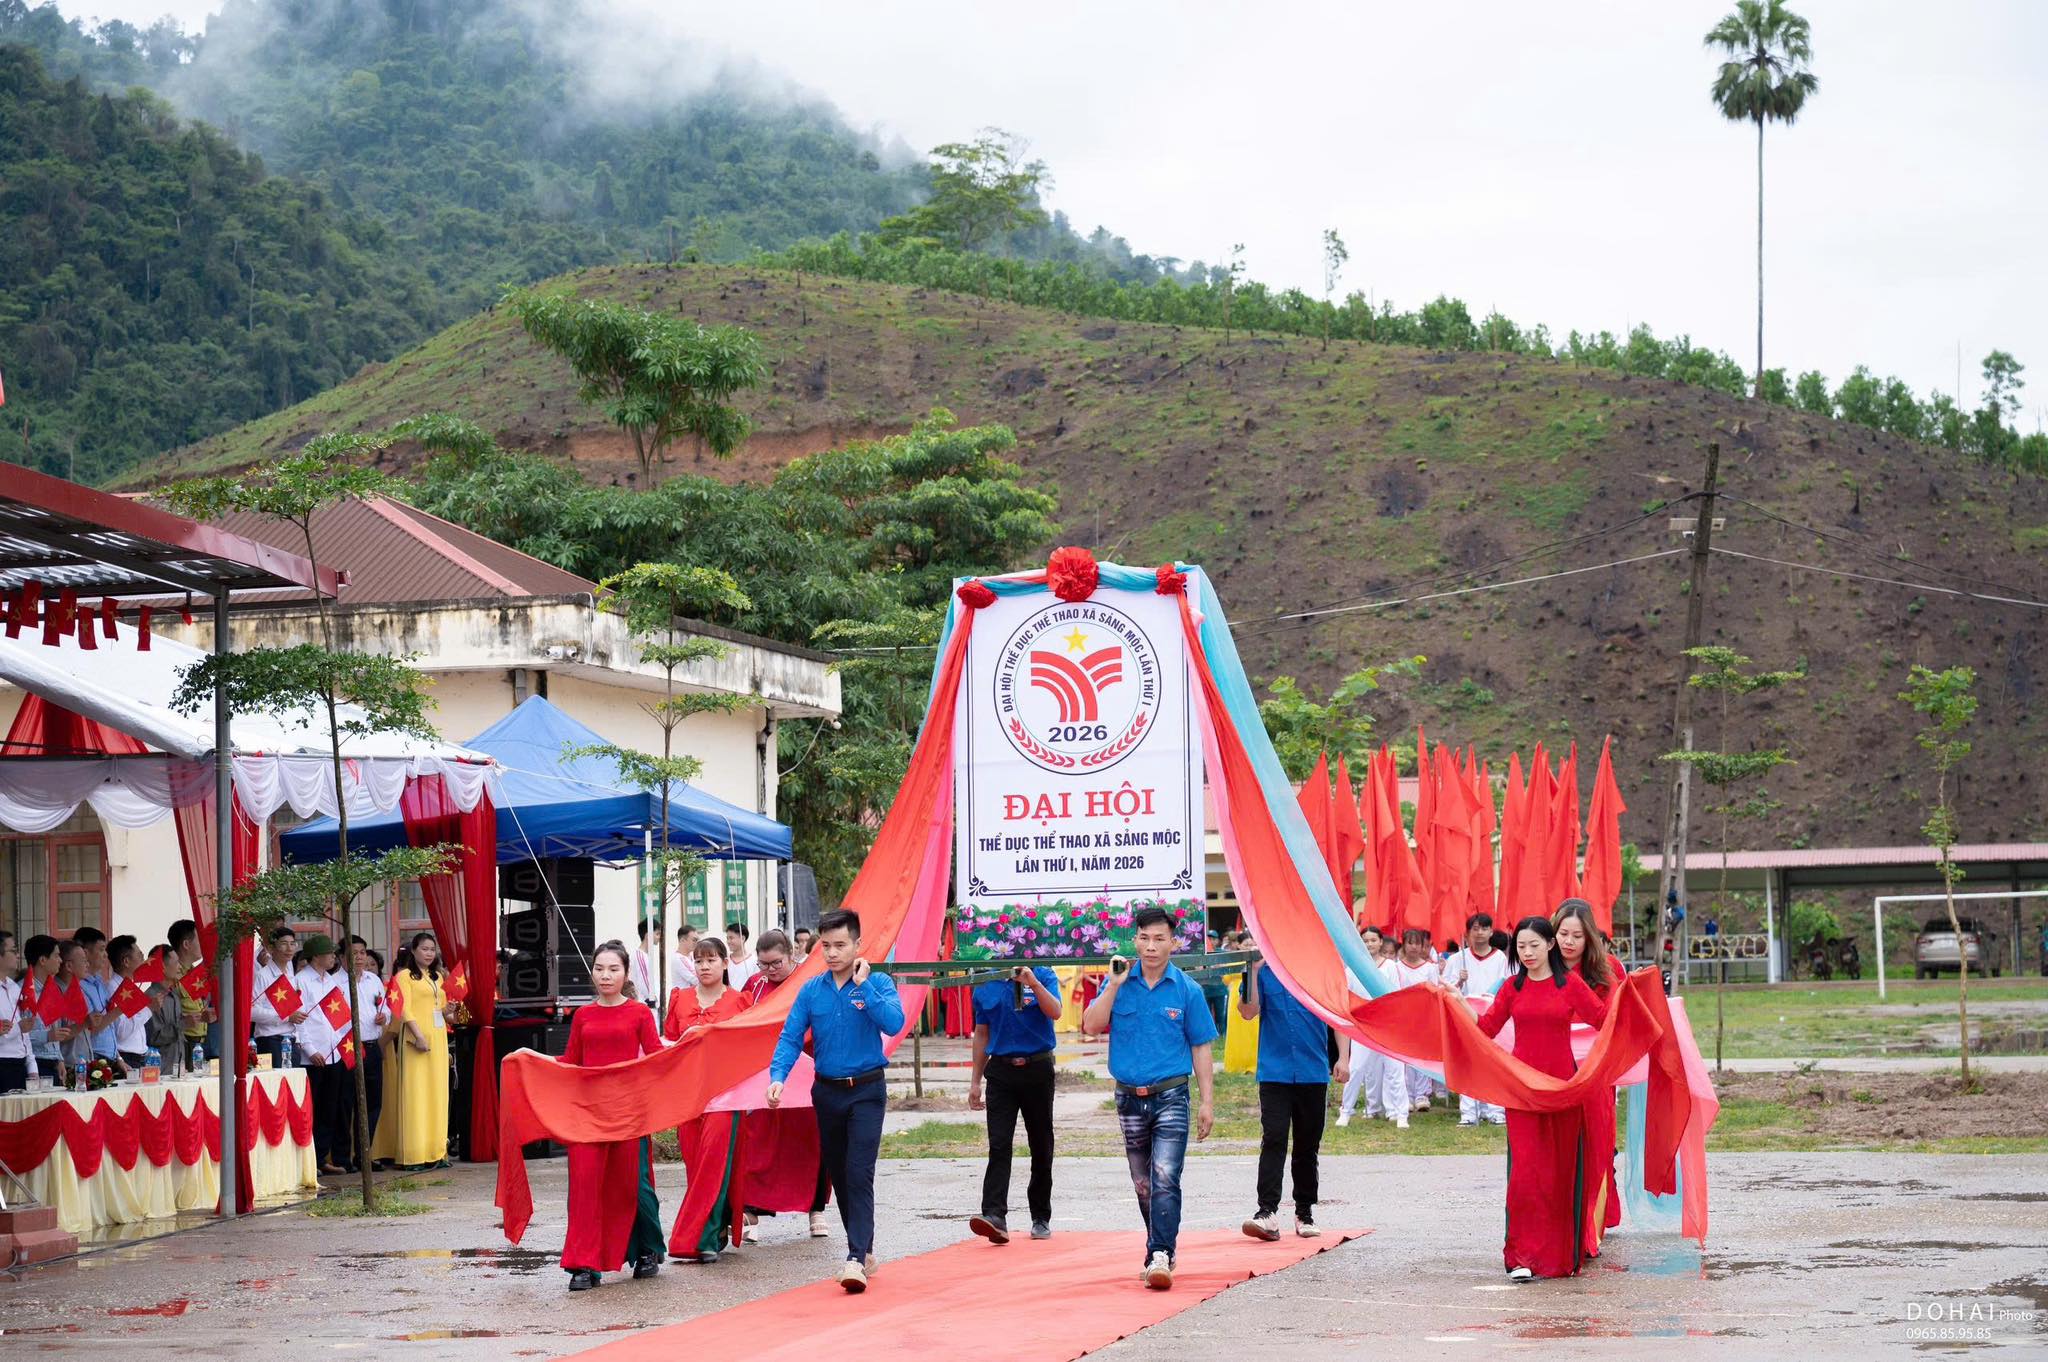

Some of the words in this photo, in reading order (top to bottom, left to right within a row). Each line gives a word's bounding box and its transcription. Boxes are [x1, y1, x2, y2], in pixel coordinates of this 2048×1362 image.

[1032, 612, 1051, 632] THỂ
[1052, 609, 1078, 622] THAO
[1082, 608, 1096, 619] XÃ
[1099, 613, 1125, 633] SẢNG
[1015, 630, 1033, 650] DỤC
[1124, 630, 1144, 653] MỘC
[1005, 648, 1019, 669] THỂ
[1000, 673, 1013, 690] HỘI
[1144, 678, 1155, 700] THỨ
[1048, 725, 1108, 742] 2026
[1003, 792, 1072, 826] ĐẠI
[1085, 781, 1155, 823] HỘI
[979, 832, 1002, 851] THỂ
[1006, 836, 1029, 853] DỤC
[1034, 830, 1056, 849] THỂ
[1060, 834, 1090, 848] THAO
[1095, 831, 1111, 847] XÃ
[1115, 828, 1148, 846] SẢNG
[1153, 829, 1181, 847] MỘC
[1016, 855, 1039, 873] LẦN
[1043, 856, 1067, 872] THỨ
[1070, 858, 1077, 873] I,
[1082, 855, 1110, 871] NĂM
[1114, 856, 1144, 869] 2026
